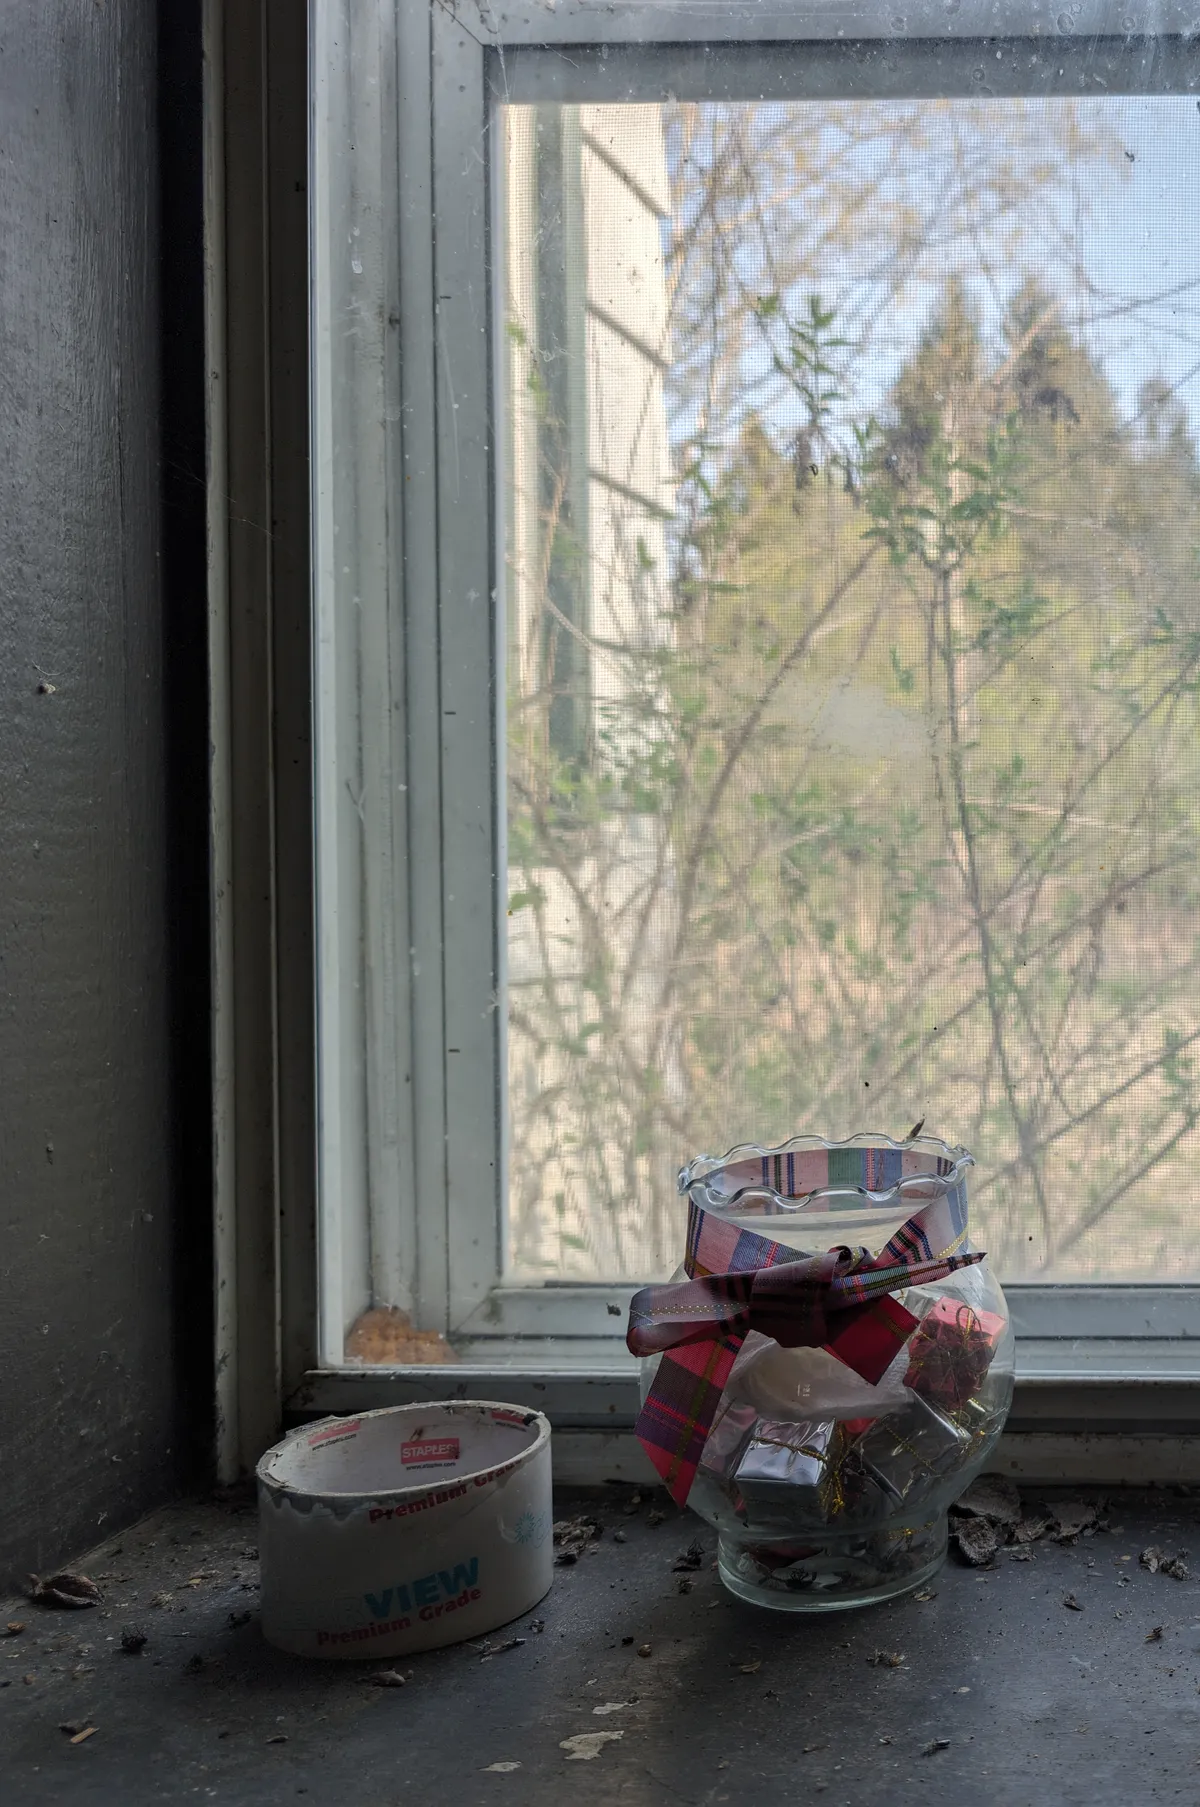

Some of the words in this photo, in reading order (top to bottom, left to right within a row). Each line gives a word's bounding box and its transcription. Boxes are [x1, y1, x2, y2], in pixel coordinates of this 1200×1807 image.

[402, 1443, 456, 1459] STAPLES
[369, 1484, 467, 1523] Premium
[316, 1616, 411, 1646] Premium
[419, 1588, 482, 1621] Grade
